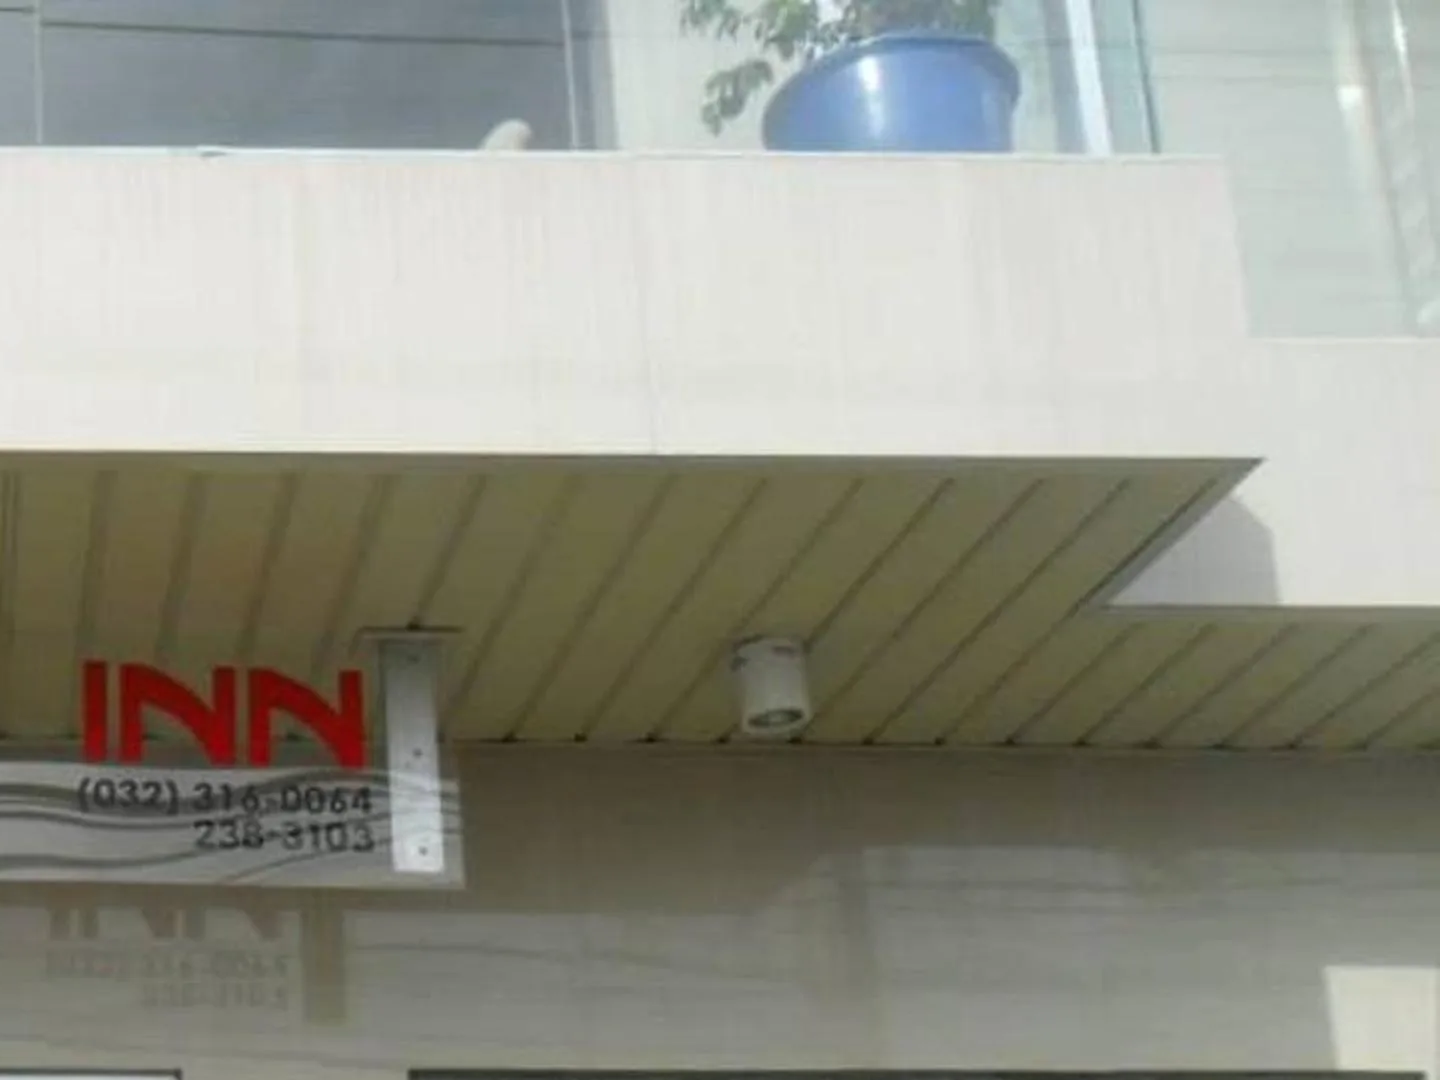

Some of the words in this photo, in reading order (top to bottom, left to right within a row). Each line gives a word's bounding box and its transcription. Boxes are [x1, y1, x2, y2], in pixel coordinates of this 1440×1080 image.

[81, 660, 371, 769] INN
[77, 777, 180, 816] (032)
[191, 782, 373, 815] 316-0064
[192, 819, 376, 853] 238-3103
